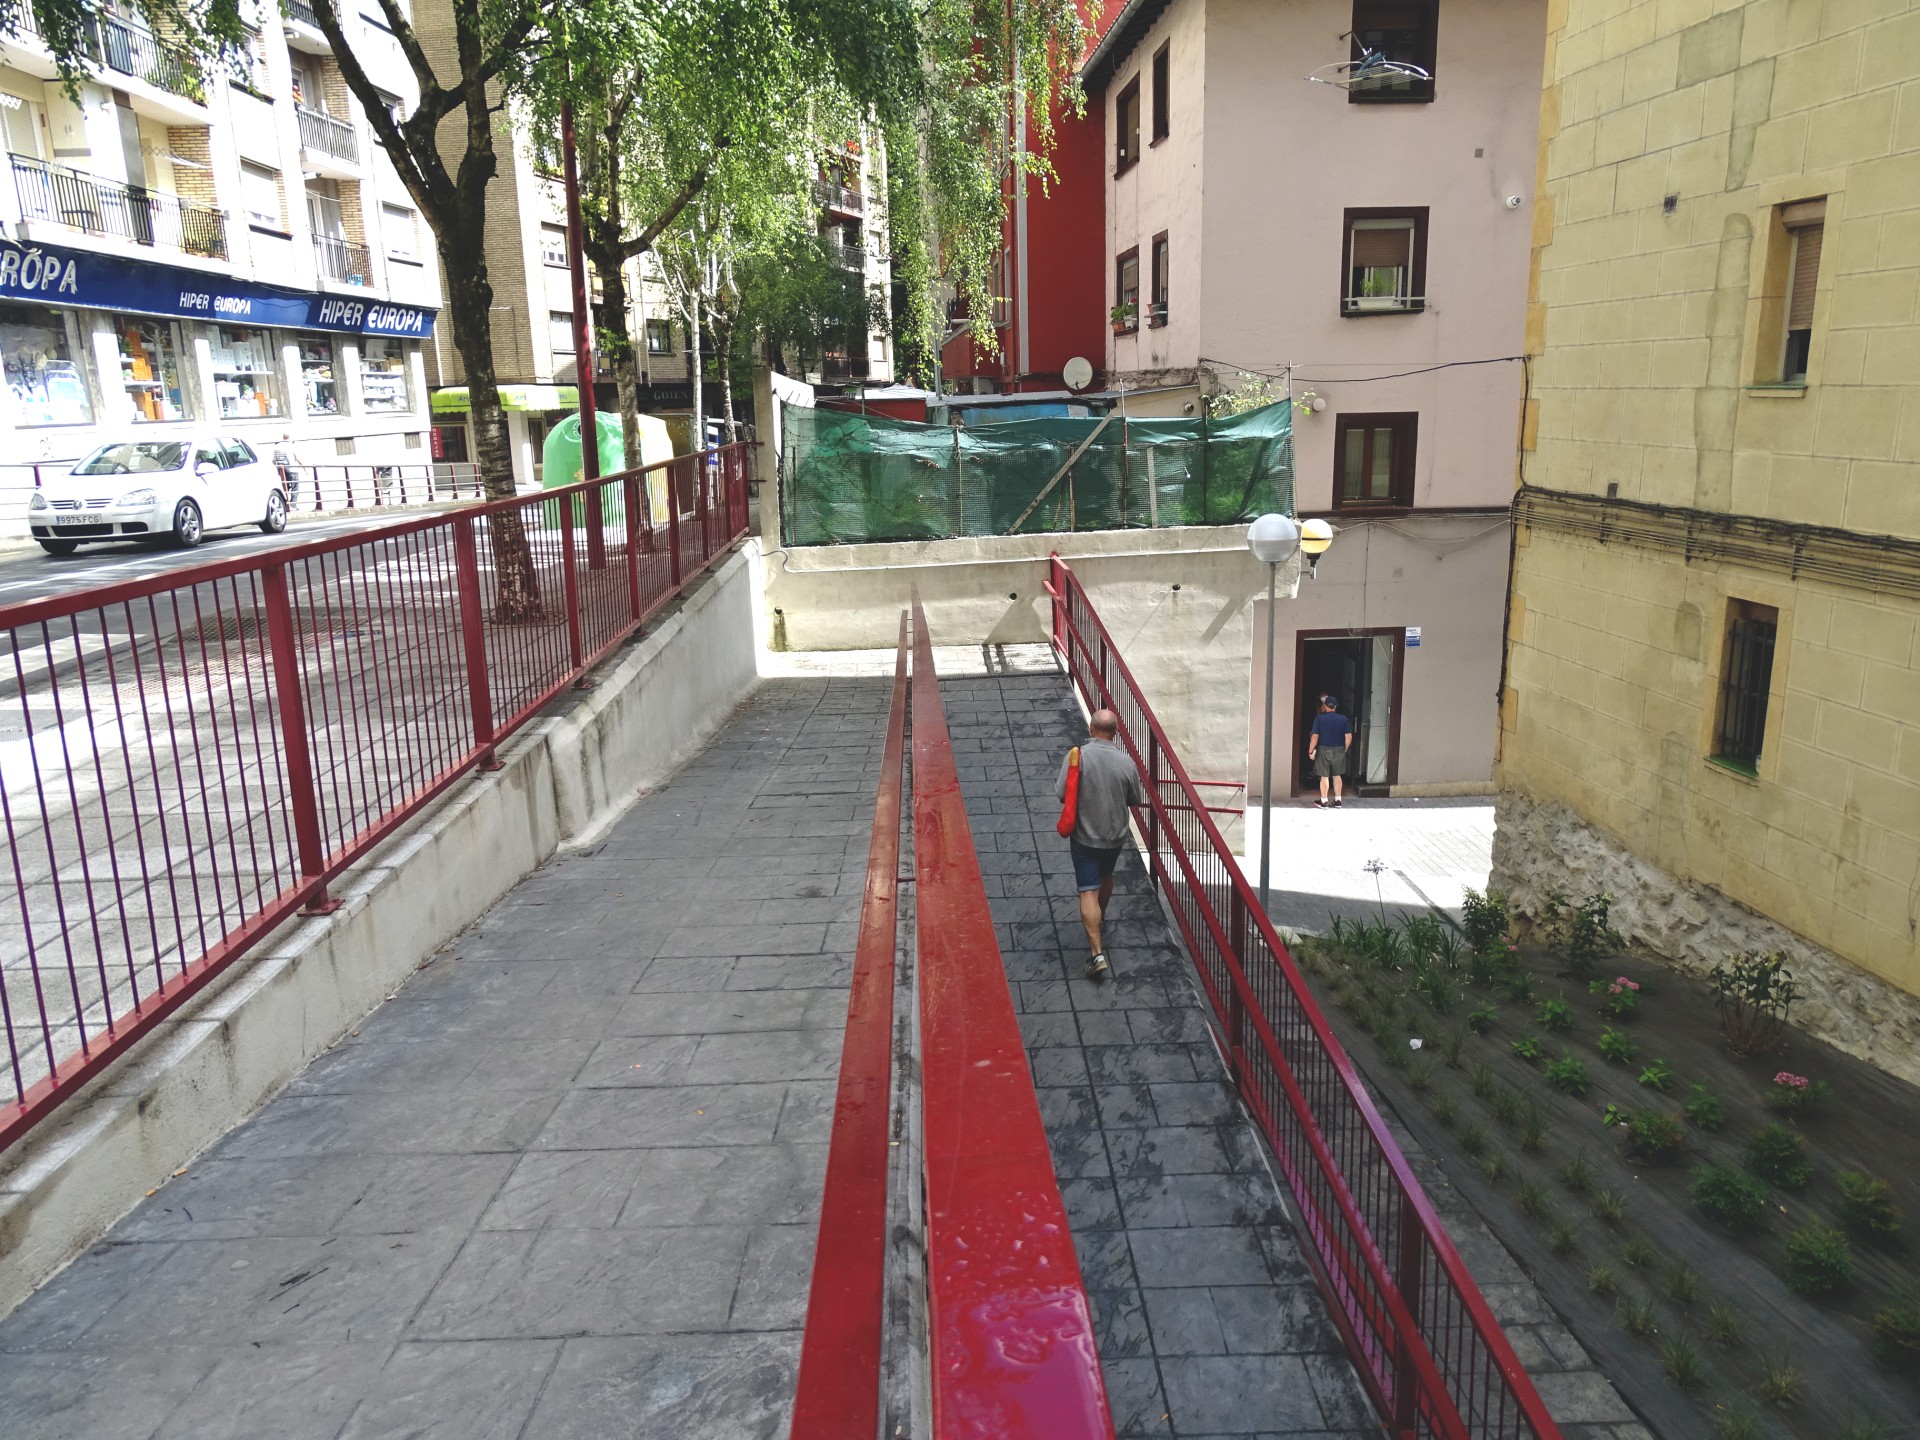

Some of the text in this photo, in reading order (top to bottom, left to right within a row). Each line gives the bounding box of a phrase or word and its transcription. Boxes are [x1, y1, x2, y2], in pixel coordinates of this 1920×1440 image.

[0, 249, 78, 294] ROPA
[60, 516, 82, 525] 9975
[82, 515, 100, 524] FCG
